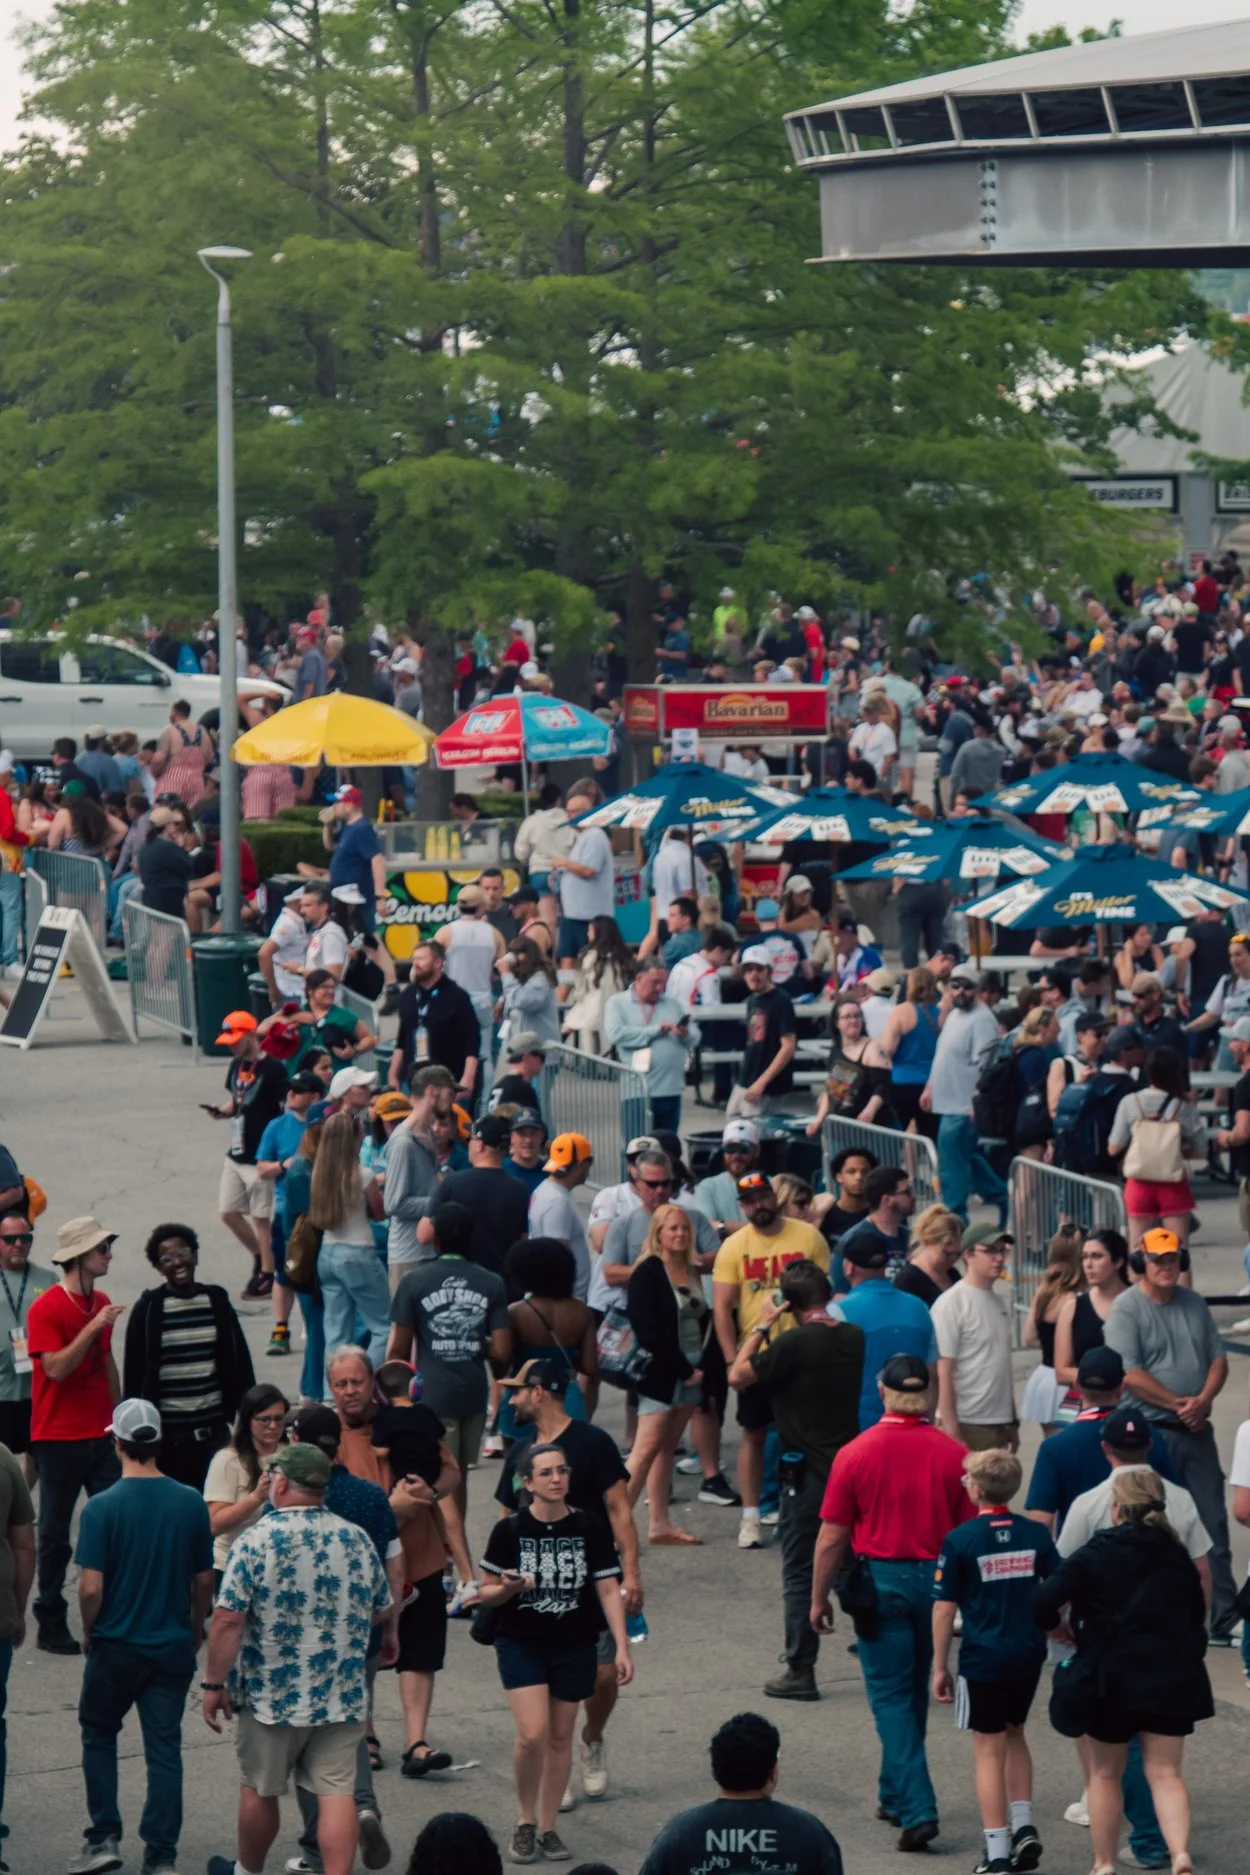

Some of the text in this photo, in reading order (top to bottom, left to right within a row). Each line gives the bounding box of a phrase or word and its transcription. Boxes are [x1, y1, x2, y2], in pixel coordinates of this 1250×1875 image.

[707, 701, 786, 718] Bavarian
[1053, 894, 1138, 919] Miller
[1096, 906, 1136, 919] TIME
[705, 1828, 779, 1853] NIKE
